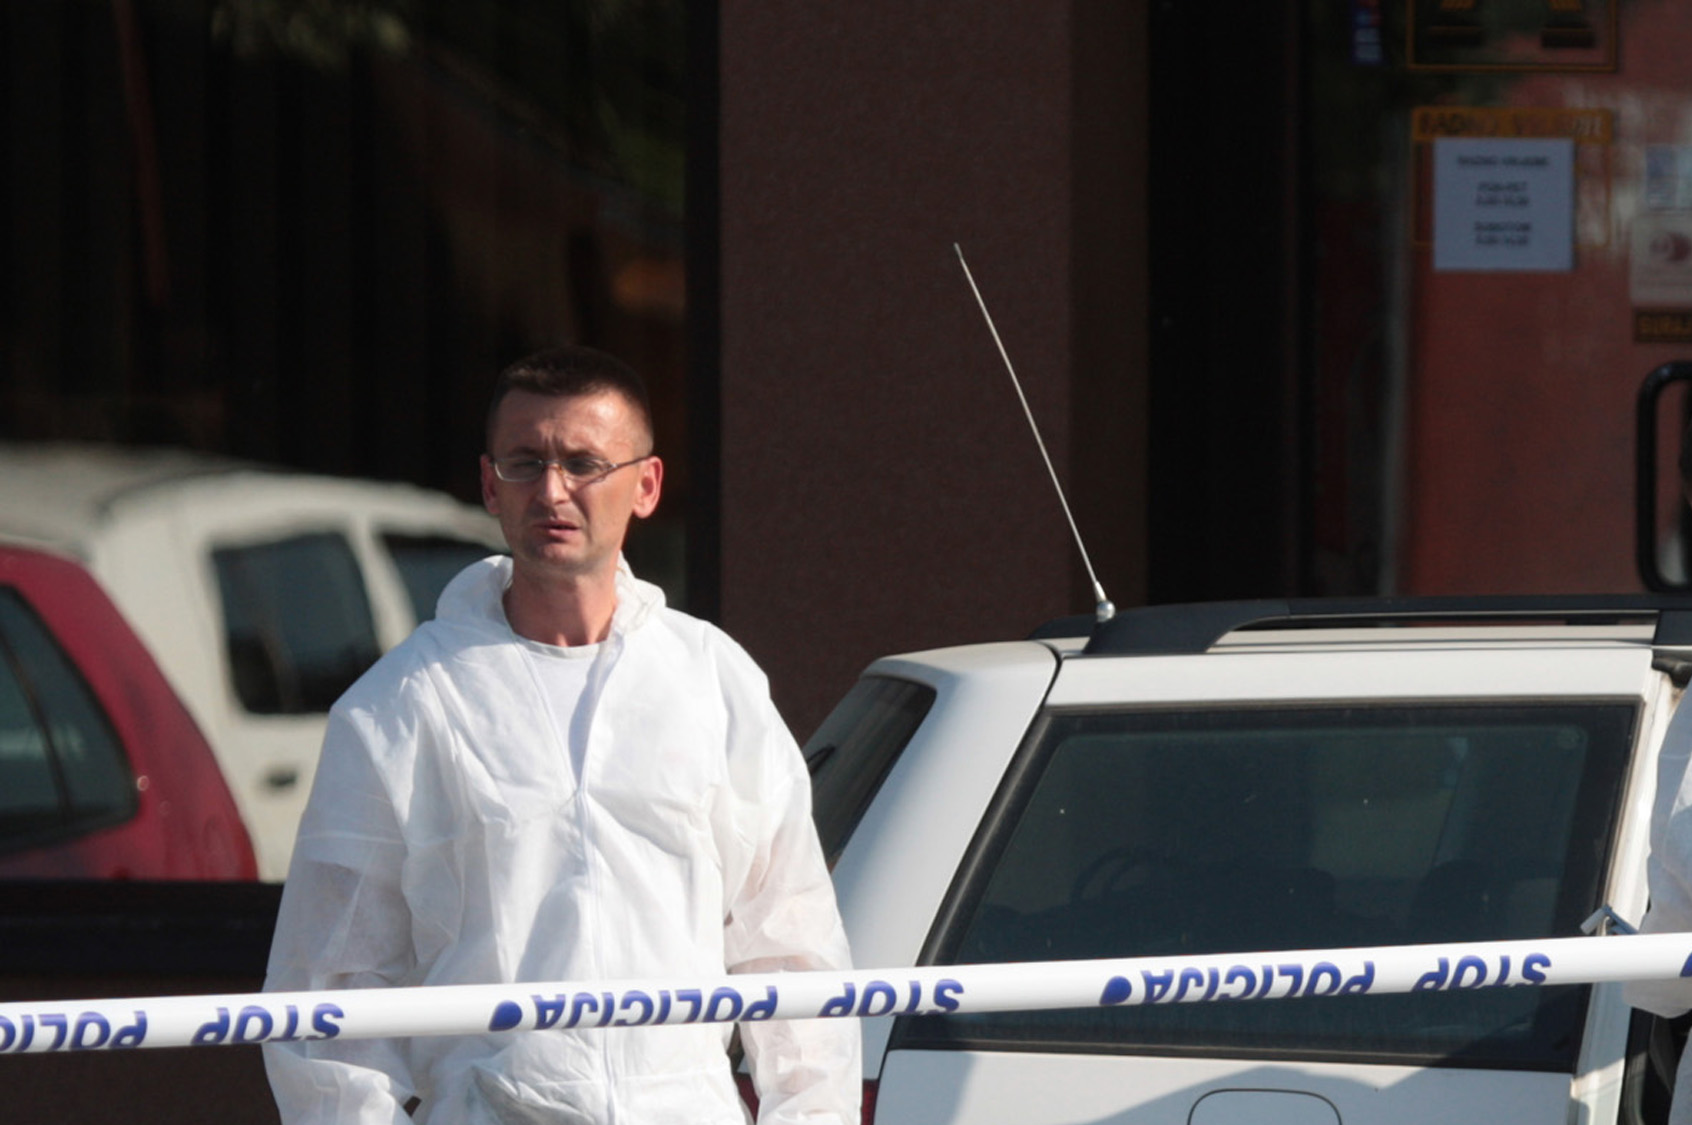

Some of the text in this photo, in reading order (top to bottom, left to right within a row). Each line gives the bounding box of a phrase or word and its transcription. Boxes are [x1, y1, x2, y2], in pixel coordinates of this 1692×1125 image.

[1139, 951, 1553, 1004] STOP POLICIJA
[194, 1003, 345, 1044] STOP
[531, 978, 965, 1028] STOP POLICIJA
